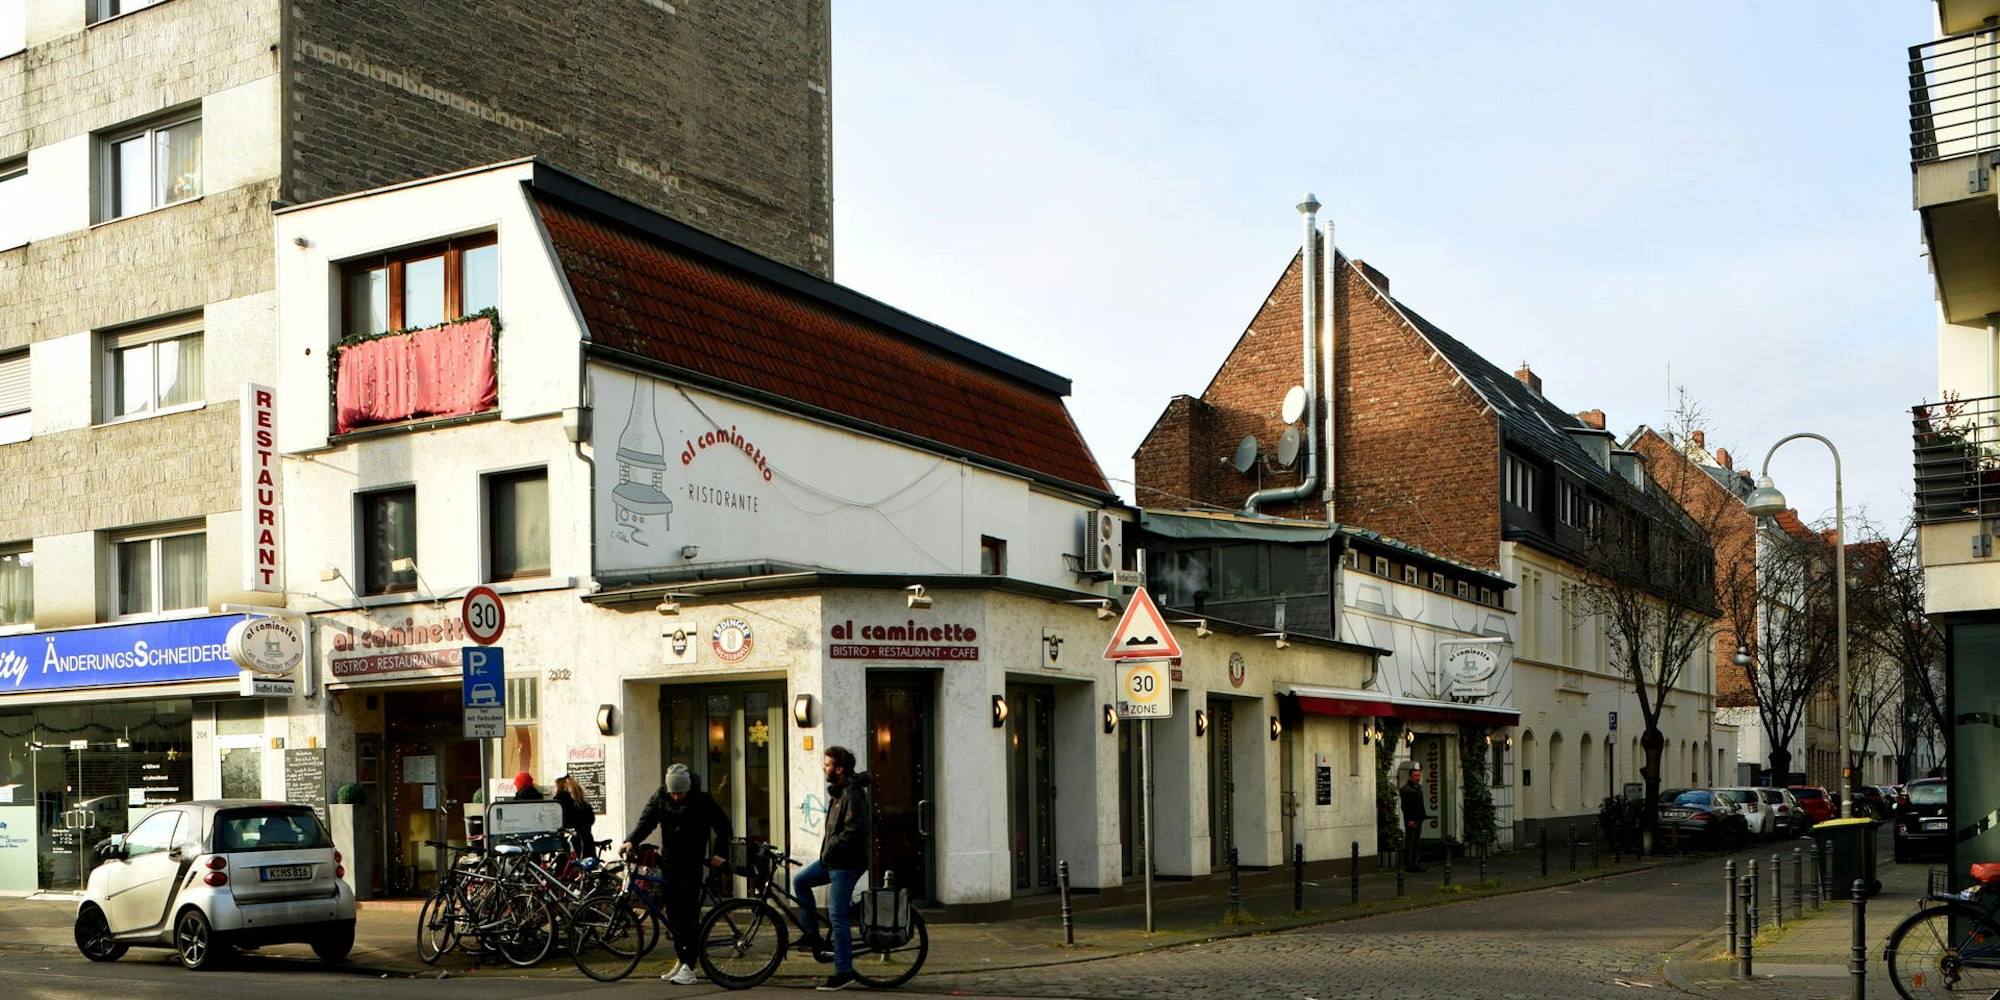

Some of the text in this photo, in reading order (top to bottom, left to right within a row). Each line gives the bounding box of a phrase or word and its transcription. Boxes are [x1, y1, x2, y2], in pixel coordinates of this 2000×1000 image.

[681, 425, 773, 482] al caminetto
[256, 390, 275, 585] RESTAURANT
[689, 483, 759, 513] RISTORANTE
[471, 603, 496, 629] 30
[246, 621, 297, 642] al caminetto
[333, 617, 466, 651] al caminett
[831, 619, 977, 642] al caminetto
[43, 637, 230, 673] ÄNDERUNGSSCHNEIDERE
[334, 658, 369, 675] BISTRO
[377, 652, 440, 670] RESTAURANT
[469, 651, 487, 676] P
[832, 646, 976, 658] BISTRO RESTAURANT CAFE
[1133, 675, 1154, 692] 30
[1130, 704, 1157, 714] ZONE
[1426, 742, 1438, 829] al caminetto
